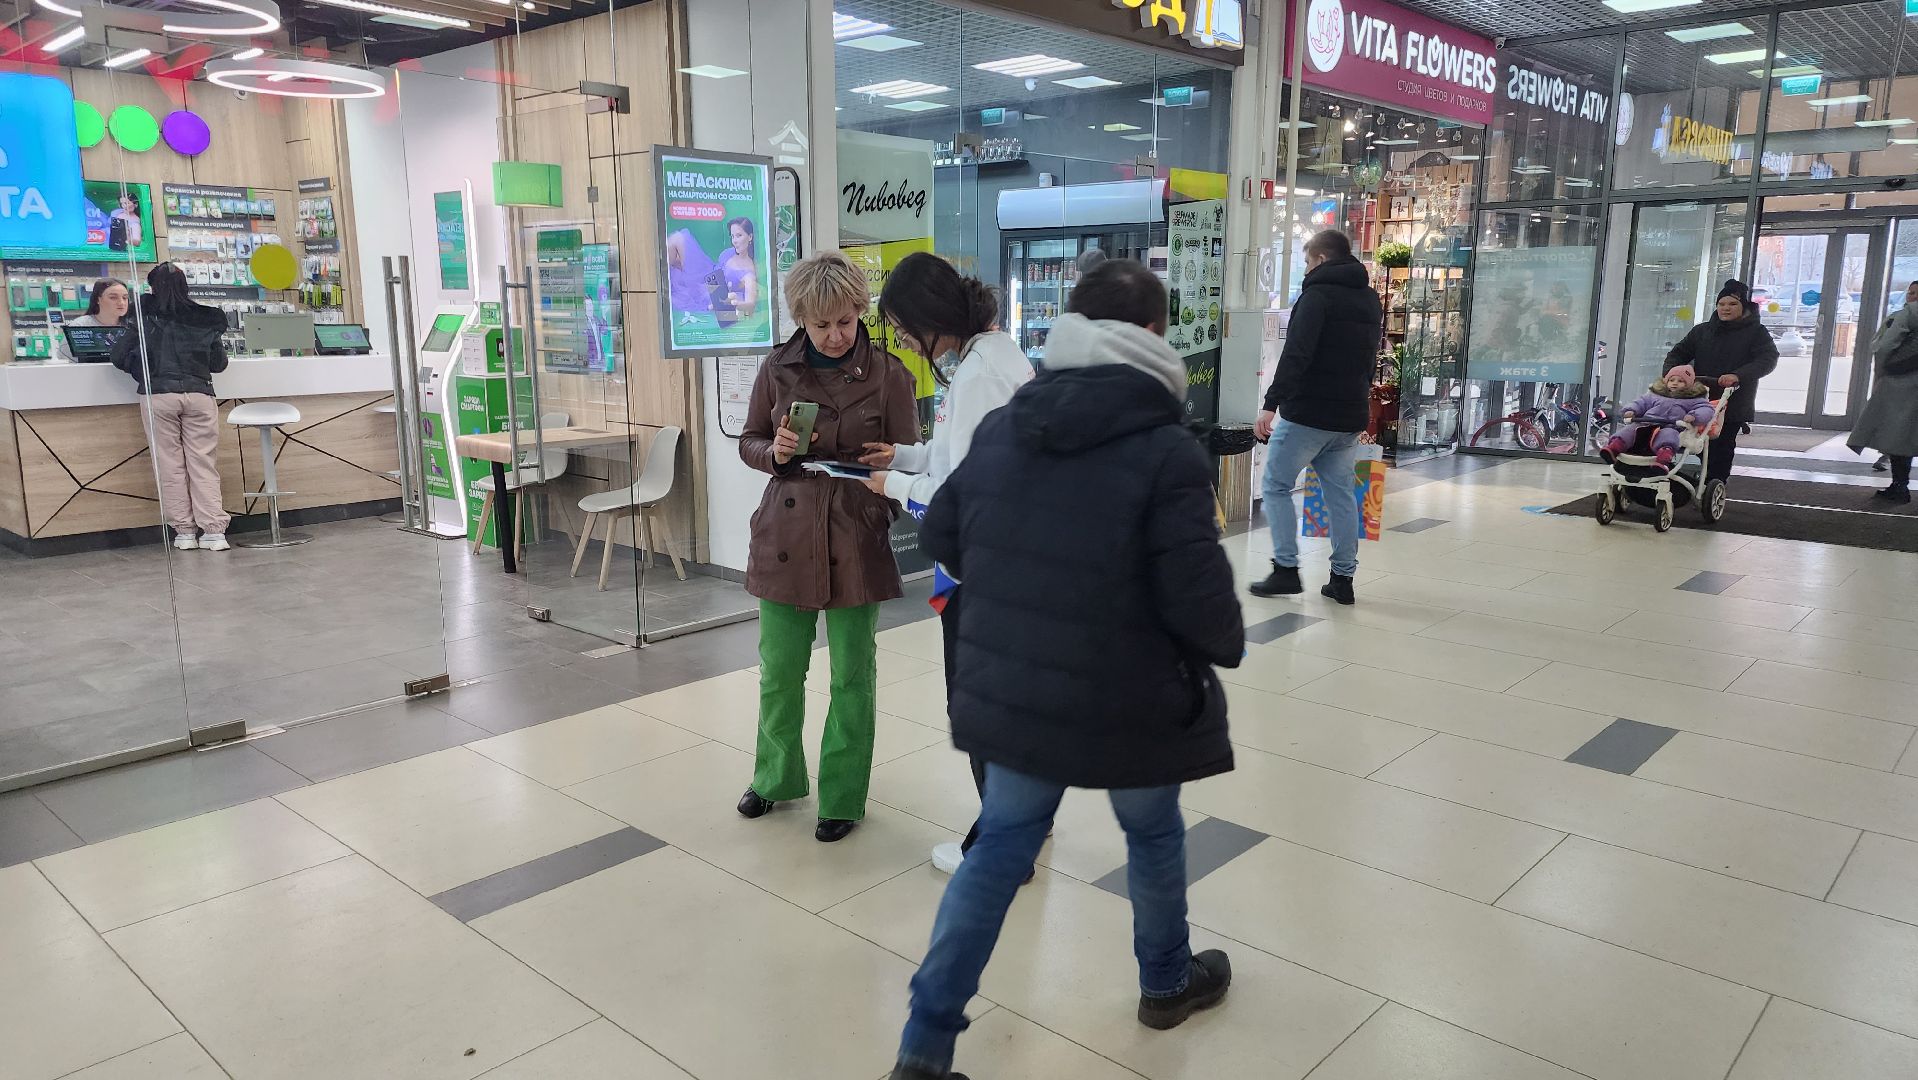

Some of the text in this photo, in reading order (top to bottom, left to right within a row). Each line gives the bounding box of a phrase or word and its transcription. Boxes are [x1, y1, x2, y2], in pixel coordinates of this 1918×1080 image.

[1351, 11, 1497, 94] VITA FLOWERS
[1397, 79, 1487, 112] СТУДИЯ ЦВЕТОВ И ПОДАРКОВ
